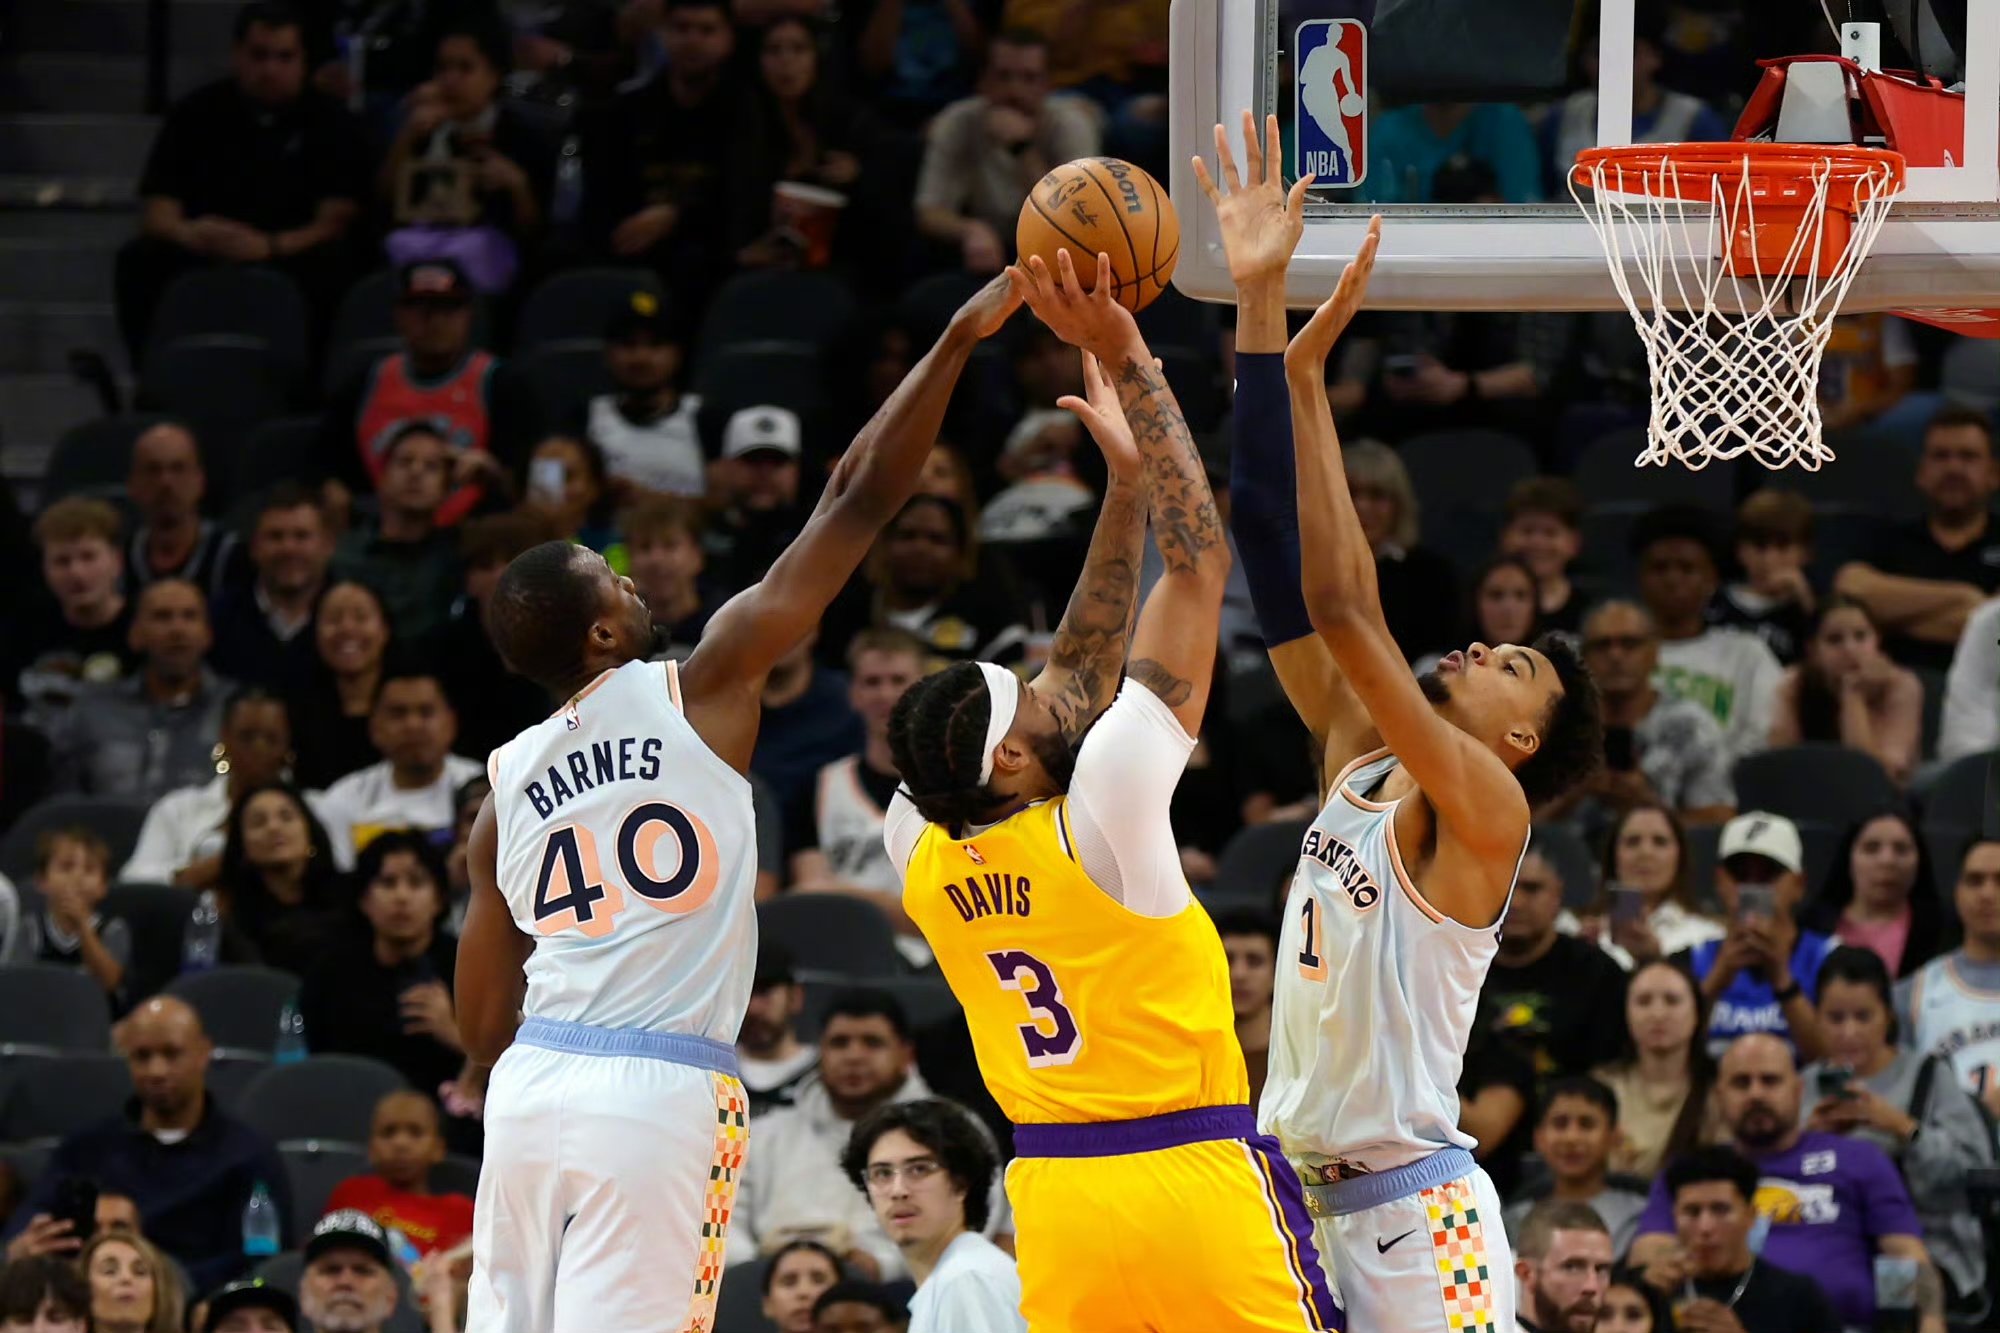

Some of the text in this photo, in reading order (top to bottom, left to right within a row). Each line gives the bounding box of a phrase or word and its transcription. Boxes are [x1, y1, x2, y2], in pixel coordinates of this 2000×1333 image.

[1306, 151, 1339, 177] NBA
[524, 737, 662, 820] BARNES
[534, 800, 714, 932] 40
[944, 872, 1031, 923] DAVIS
[1299, 897, 1327, 980] 1
[983, 949, 1084, 1070] 3
[1801, 1150, 1837, 1176] 23
